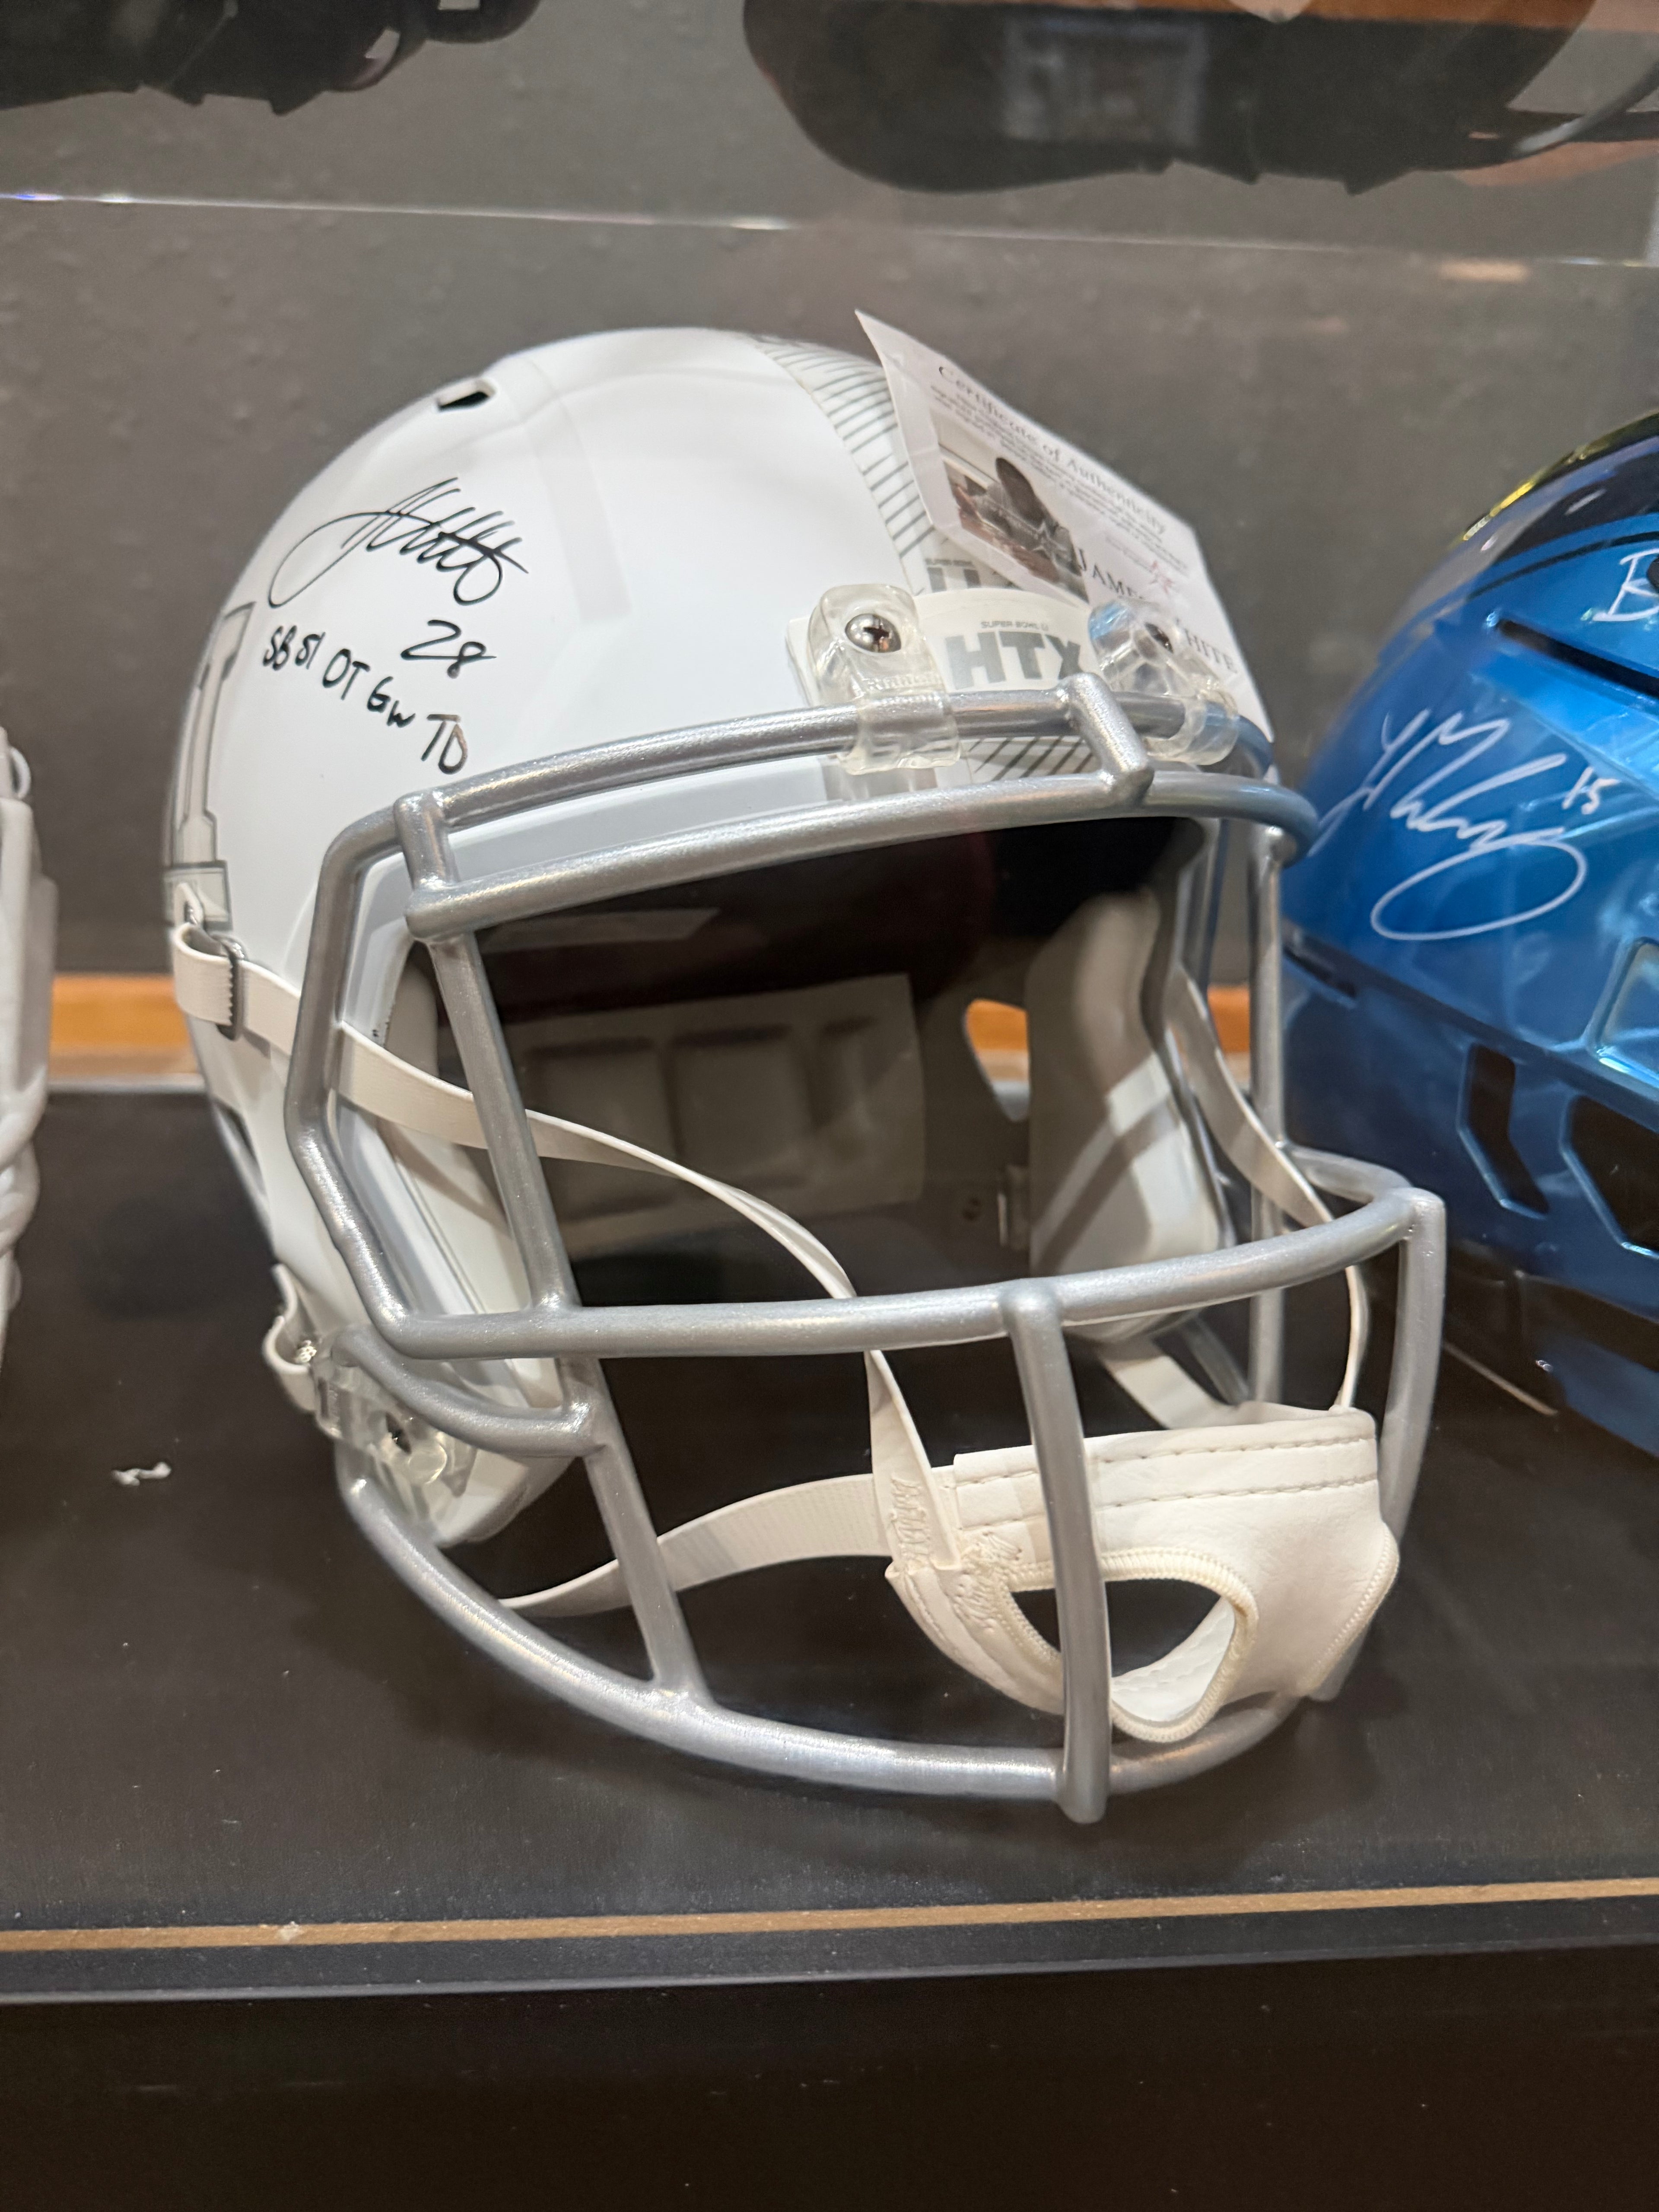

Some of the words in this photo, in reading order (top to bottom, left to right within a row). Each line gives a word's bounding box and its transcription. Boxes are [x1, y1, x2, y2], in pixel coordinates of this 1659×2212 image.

[938, 366, 1037, 442] Certificate
[1042, 444, 1060, 462] of
[1067, 458, 1166, 535] Authenticity
[980, 620, 1013, 629] SUPER
[1078, 548, 1145, 599] JAME
[1174, 617, 1238, 674] HITE
[400, 619, 498, 679] 28
[944, 631, 1081, 690] HTX
[262, 625, 297, 671] SB
[295, 631, 326, 670] 51
[322, 648, 371, 701] OT
[421, 714, 468, 775] TD
[1561, 765, 1622, 815] 15
